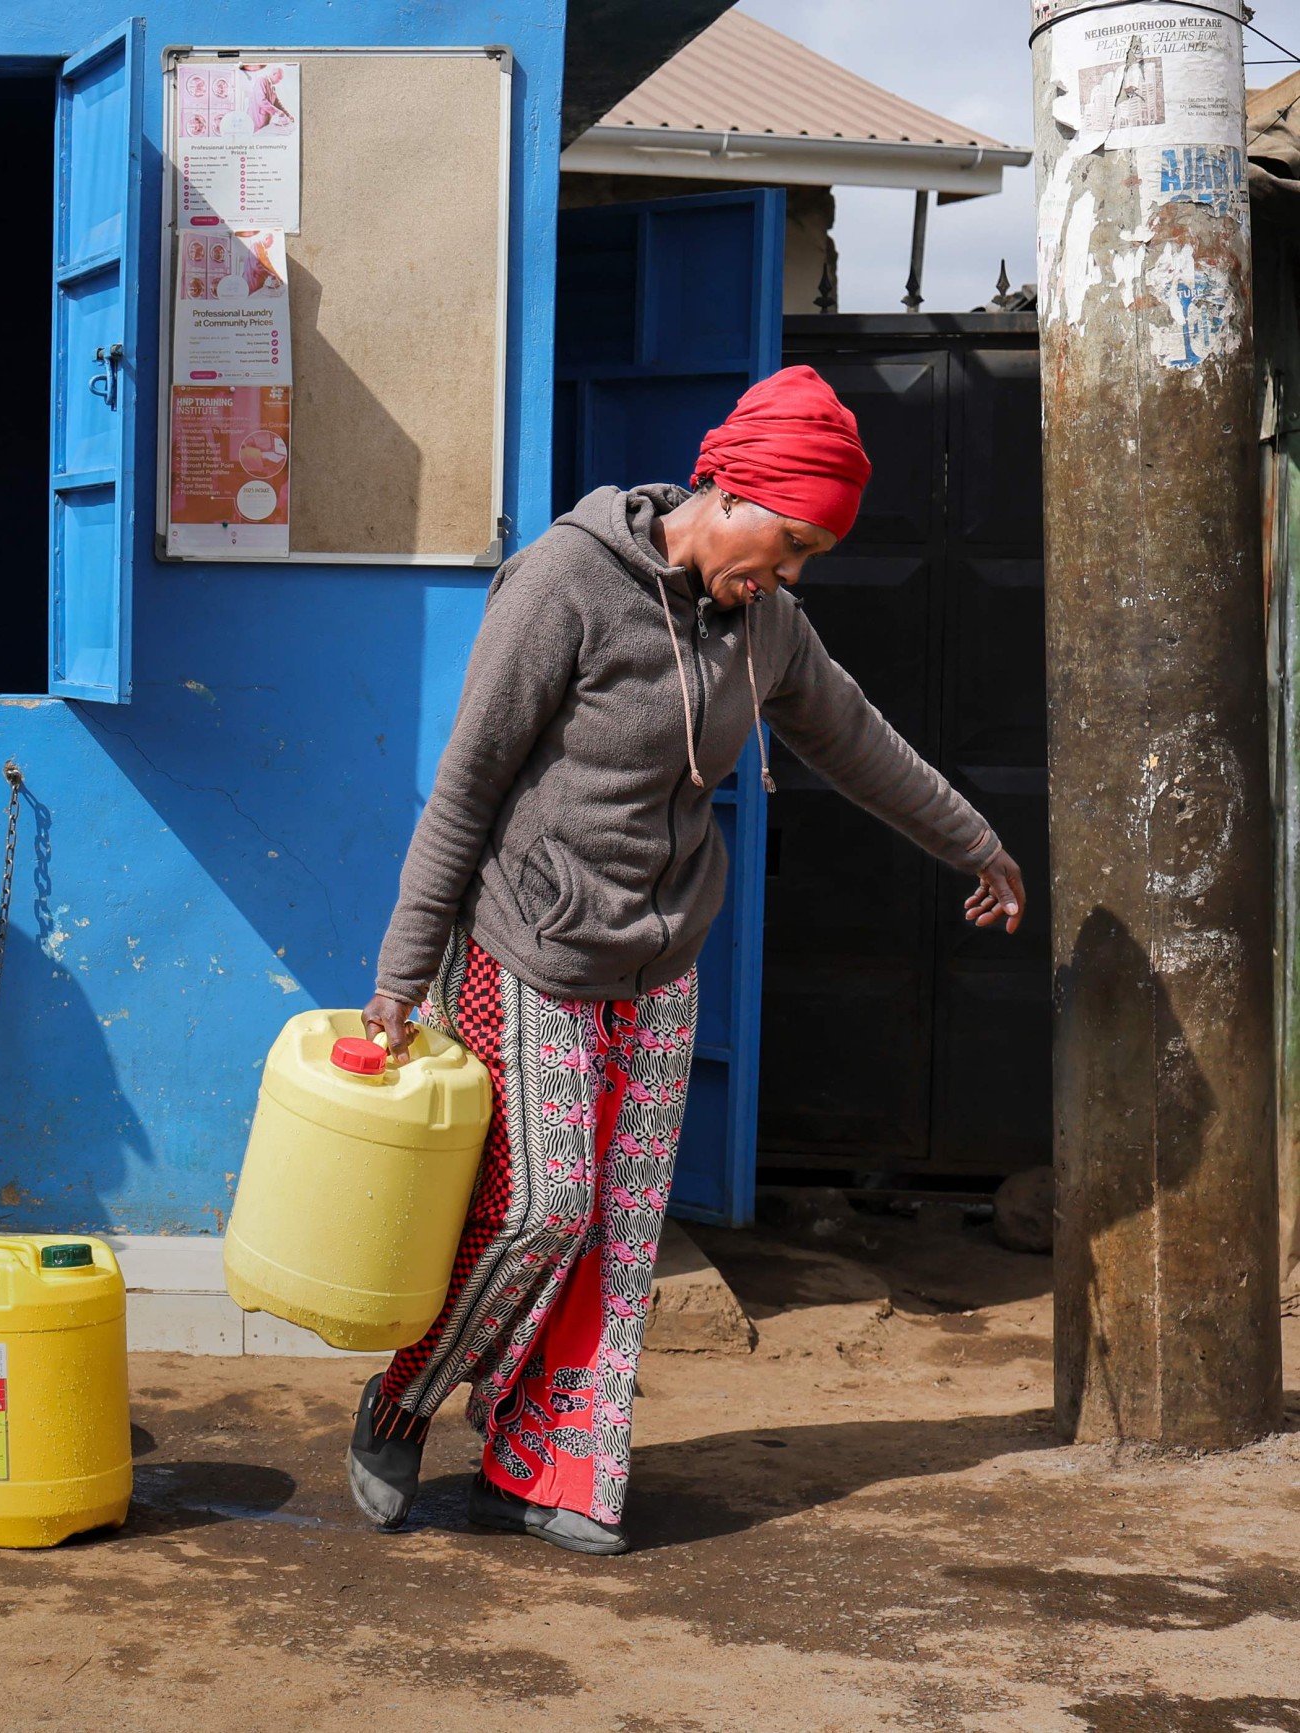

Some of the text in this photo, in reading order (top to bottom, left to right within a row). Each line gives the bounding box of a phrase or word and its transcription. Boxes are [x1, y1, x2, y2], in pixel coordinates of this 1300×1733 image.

[1084, 17, 1222, 40] NEIGHBOURHOOD WELFARE
[1152, 30, 1196, 42] CHAIRS
[192, 309, 273, 318] Professional Laundry
[203, 319, 247, 328] Community
[177, 398, 233, 407] HNP TRAINING
